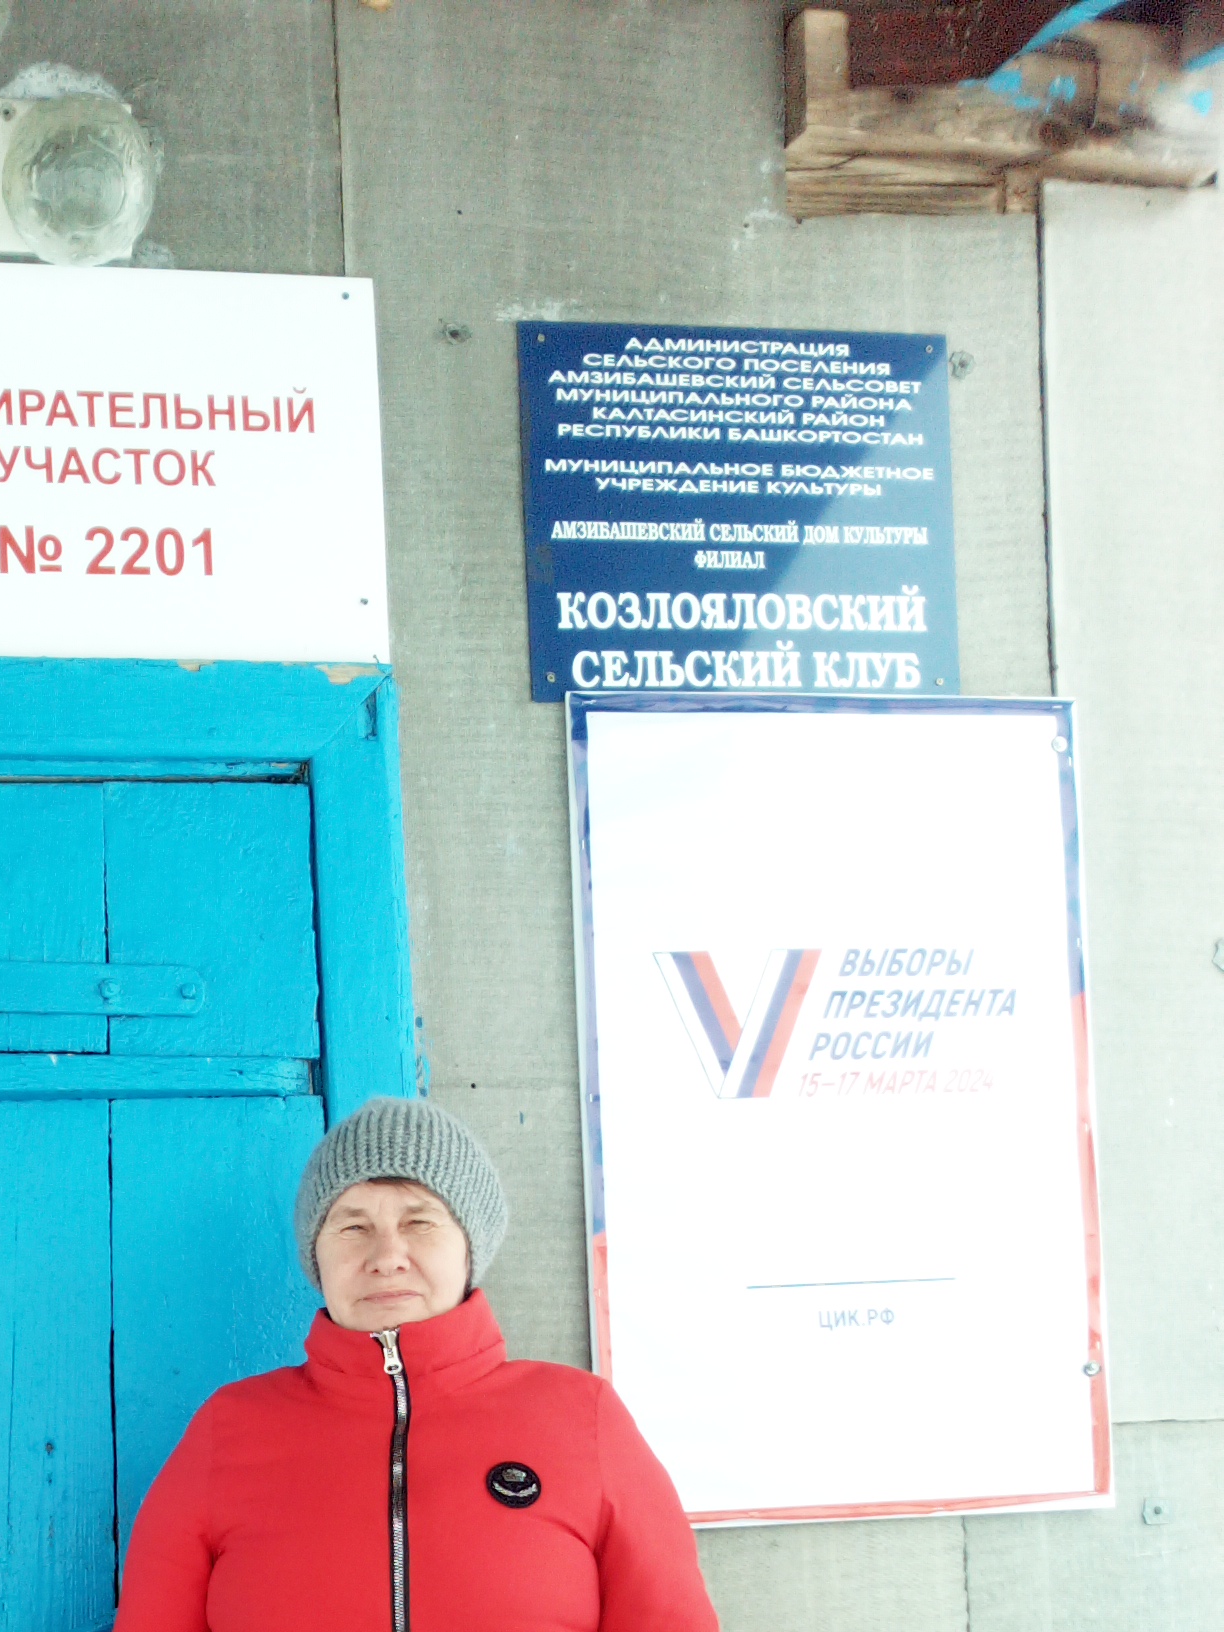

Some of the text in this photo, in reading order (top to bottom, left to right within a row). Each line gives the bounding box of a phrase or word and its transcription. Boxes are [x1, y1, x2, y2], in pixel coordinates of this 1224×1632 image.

[625, 337, 850, 357] АДМИНИСТРАЦИЯ
[583, 353, 891, 376] СЕЛЬСКОГО ПОСЕЛЕНИЯ
[549, 370, 922, 394] АМЗИБАШЕВСКИЙ СЕЛЬСОВЕТ
[556, 388, 912, 411] МУНИЦИПАЛЬНОГО РАЙОНА
[593, 407, 885, 428] КАЛТАСИНСКИЙ РАЙОН
[558, 424, 924, 446] РЕСПУБЛИКИ БАШКОРТОСТАН
[545, 459, 934, 481] МУНИЦИПАЛЬНОЕ БЮДЖЕТНОЕ
[596, 478, 882, 497] УЧРЕЖДЕНИЕ КУЛЬТУРЫ
[551, 518, 929, 545] АМЗИБАШЕВСКИЙ СЕЛЬСКИЙ ДОМ КУЛЬТУРЫ
[84, 526, 213, 576] 2201
[694, 550, 766, 569] ФИЛИАЛ
[557, 585, 927, 632] КОЗЛОЯЛОВСКИЙ
[572, 640, 922, 688] СЕЛЬСКИЙ КЛУБ
[839, 948, 974, 977] ВЫБОРЫ
[823, 988, 1017, 1021] ПРЕЗИДЕНТА
[809, 1031, 934, 1061] РОССИИ
[863, 1070, 937, 1096] МАРТА
[943, 1068, 994, 1093] 2024
[819, 1307, 895, 1331] ЦИК.РФ
